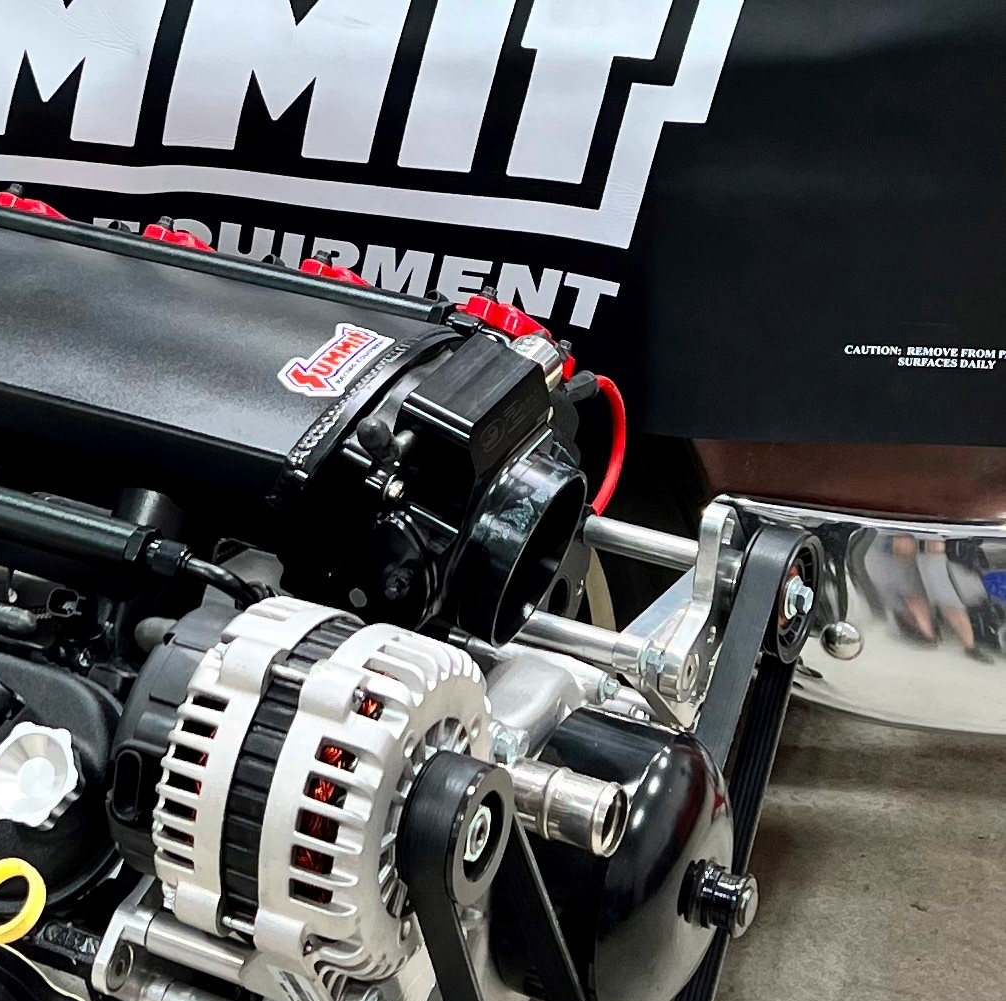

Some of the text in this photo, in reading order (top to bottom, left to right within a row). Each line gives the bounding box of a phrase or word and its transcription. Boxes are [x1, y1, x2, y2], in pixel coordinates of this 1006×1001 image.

[844, 345, 902, 356] CAUTION:
[906, 347, 958, 357] REMOVE
[961, 348, 995, 359] FROM
[290, 331, 371, 389] SUMMIT
[897, 357, 997, 369] SURFACES DAILY
